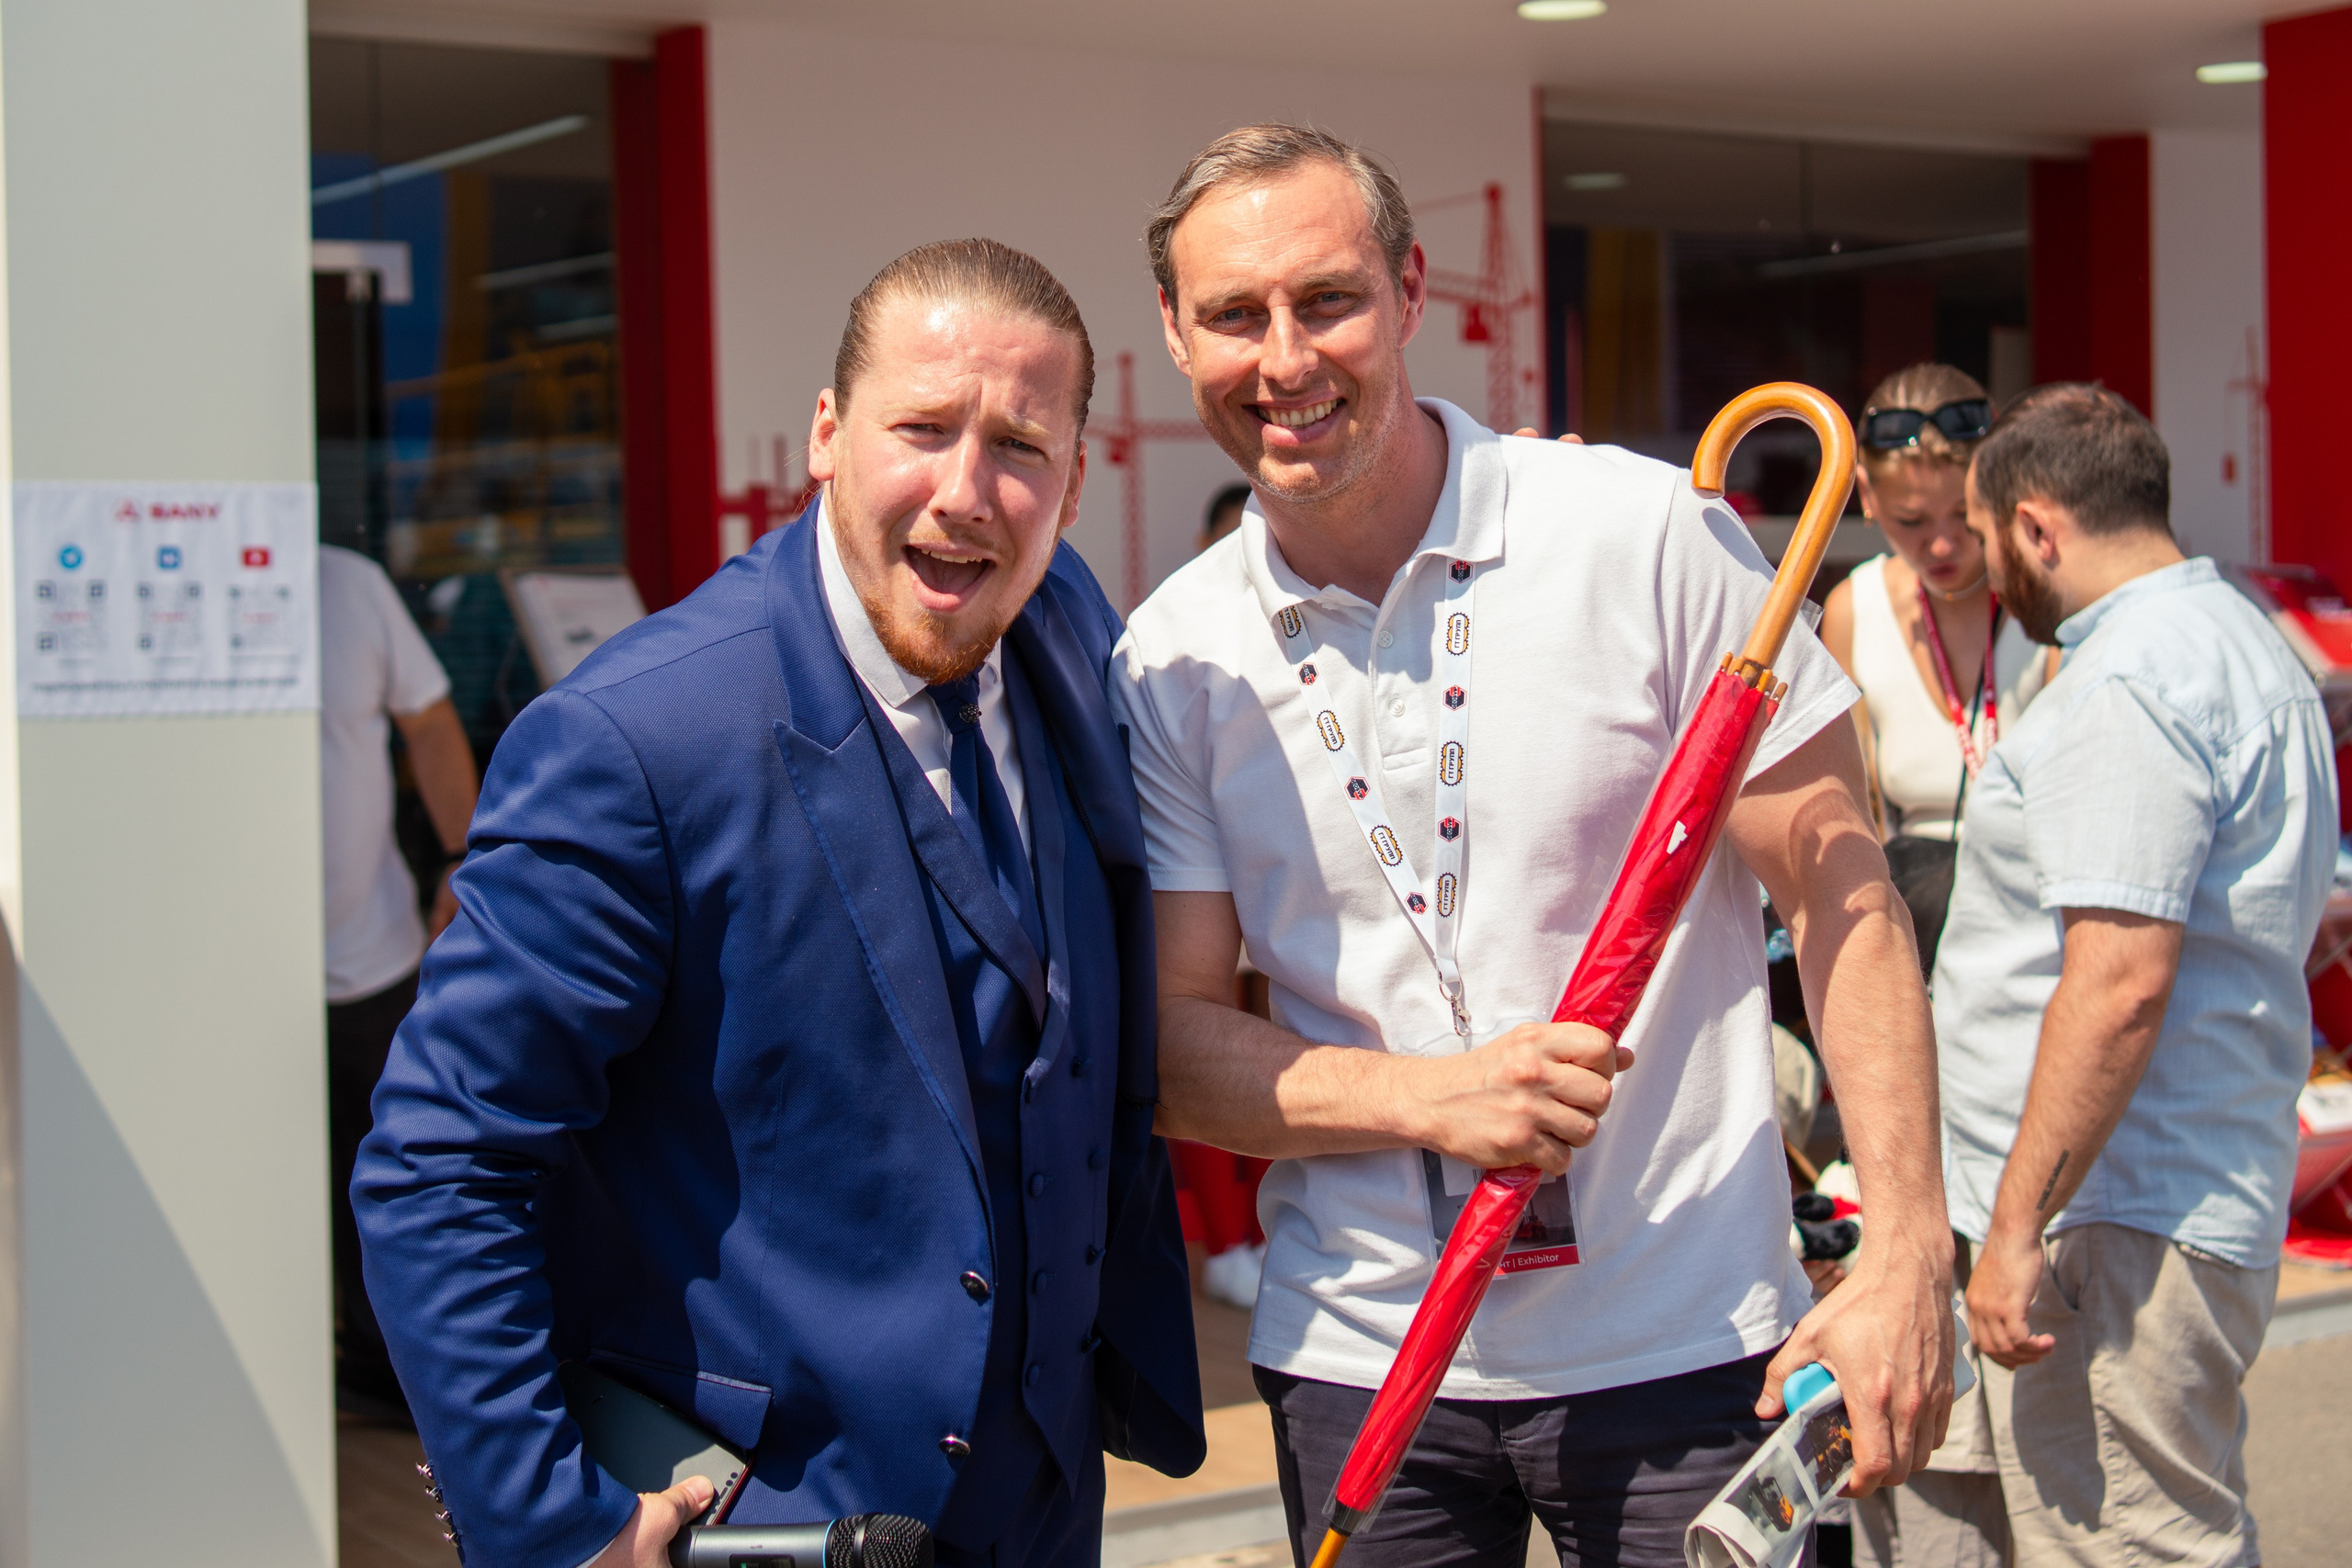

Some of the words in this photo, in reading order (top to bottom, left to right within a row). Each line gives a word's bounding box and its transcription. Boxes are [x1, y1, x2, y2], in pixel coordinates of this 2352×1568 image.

[1284, 613, 1295, 632] ГРУПП
[1327, 725, 1338, 745] ГРУПП
[1384, 840, 1396, 860] ГРУПП
[1517, 1254, 1560, 1267] Exhibitor
